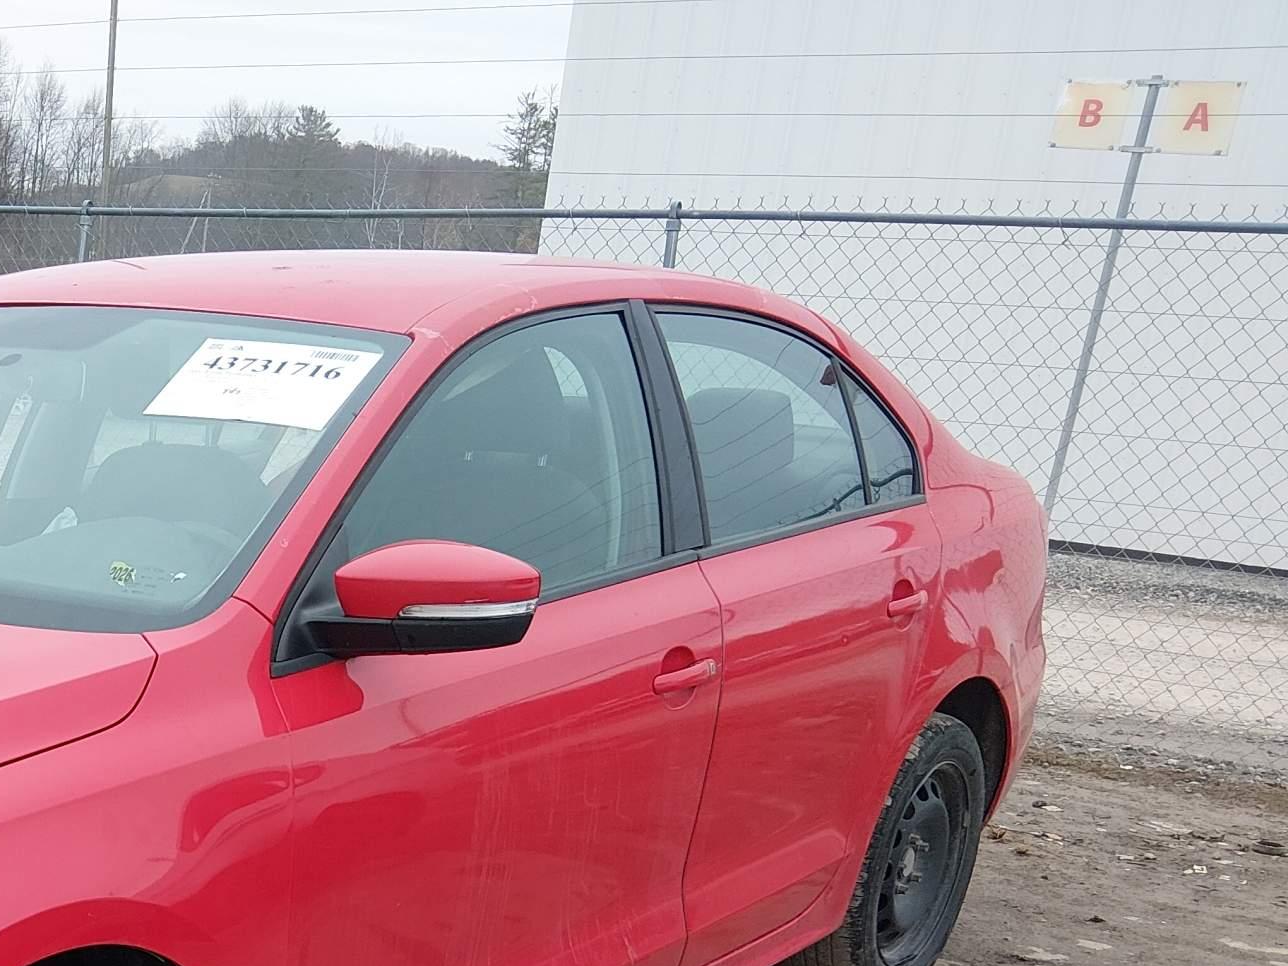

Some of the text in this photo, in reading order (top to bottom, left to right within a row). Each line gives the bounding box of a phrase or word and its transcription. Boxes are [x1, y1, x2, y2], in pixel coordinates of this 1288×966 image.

[1078, 99, 1104, 127] B
[1183, 102, 1209, 132] A
[202, 355, 345, 380] 43731716
